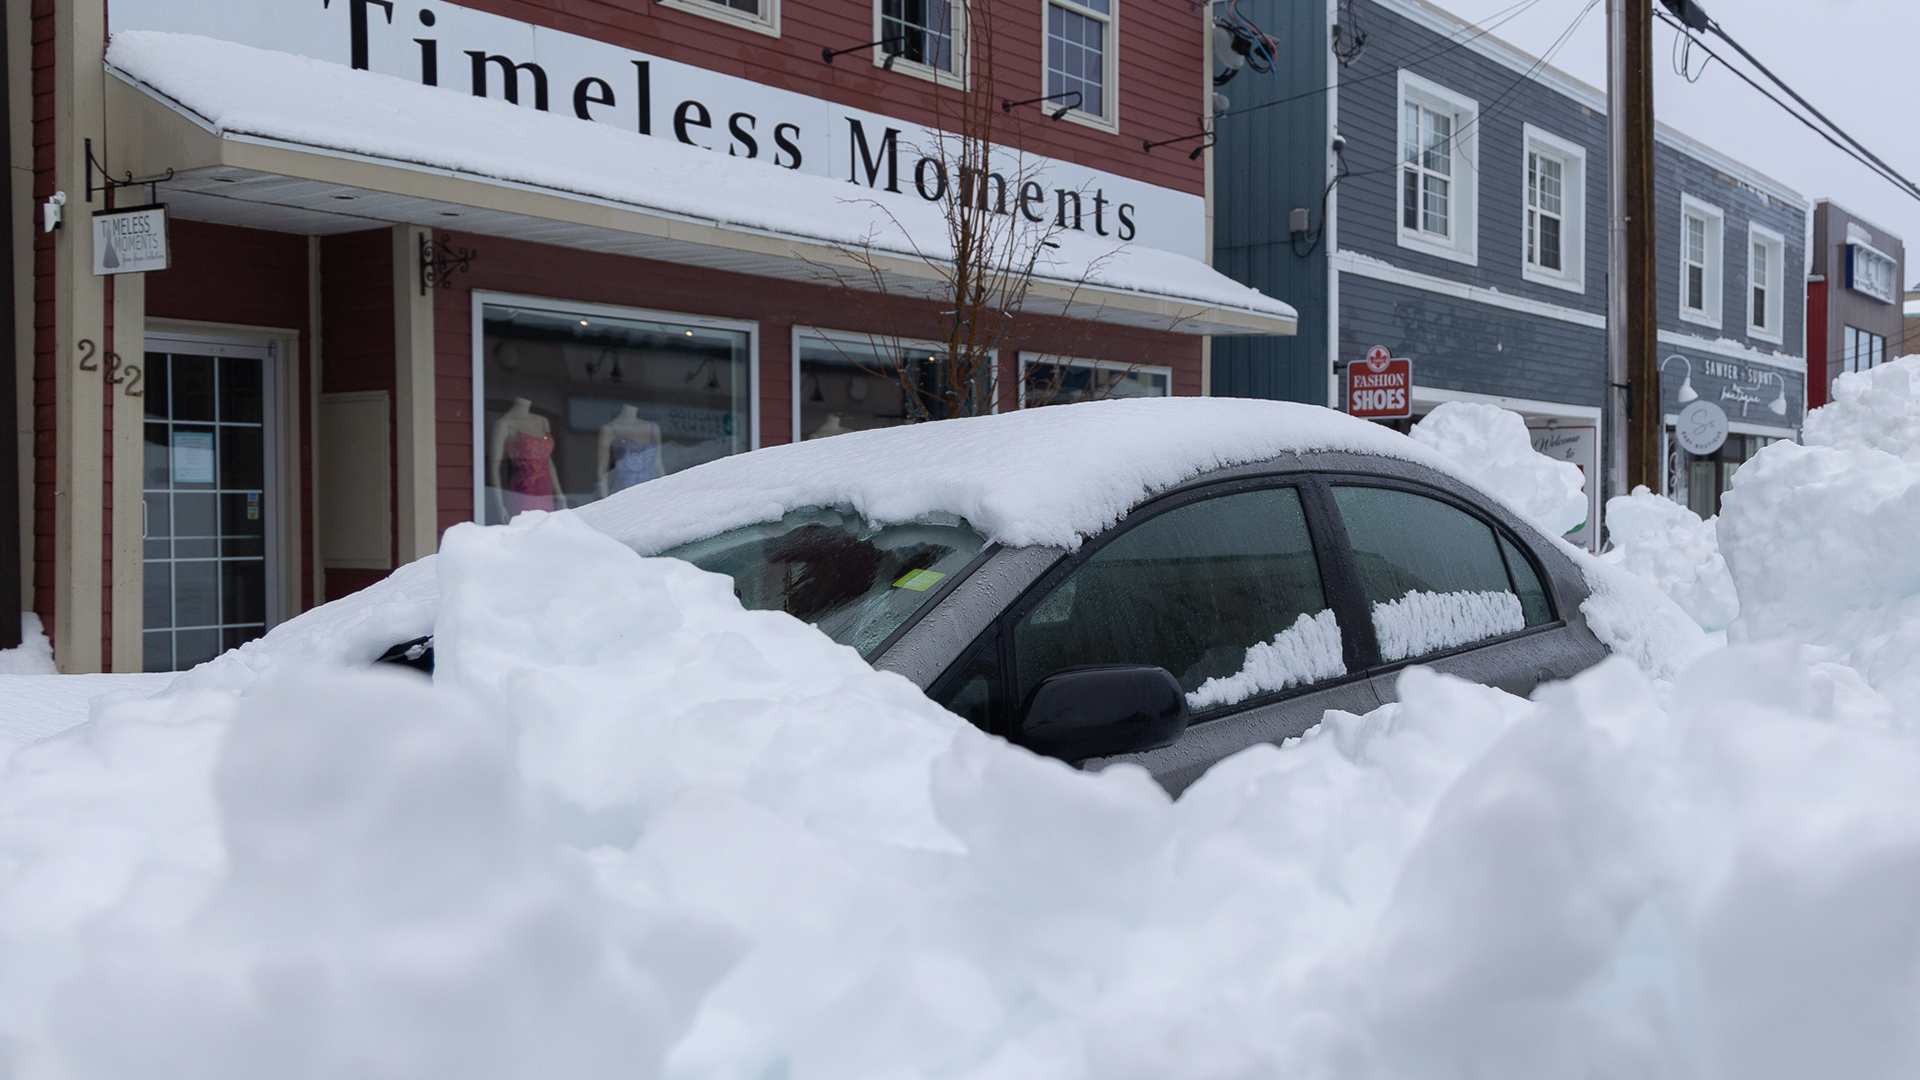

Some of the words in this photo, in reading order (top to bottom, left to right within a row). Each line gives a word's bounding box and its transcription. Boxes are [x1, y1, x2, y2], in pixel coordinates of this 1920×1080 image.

[323, 0, 803, 170] Timeless
[844, 116, 1136, 241] Moments
[114, 233, 158, 252] MOMENTS
[1705, 360, 1738, 379] SAWYER
[1353, 373, 1405, 388] FASHION
[1352, 388, 1405, 411] SHOES
[1534, 435, 1580, 451] Welcome
[1565, 447, 1575, 459] to
